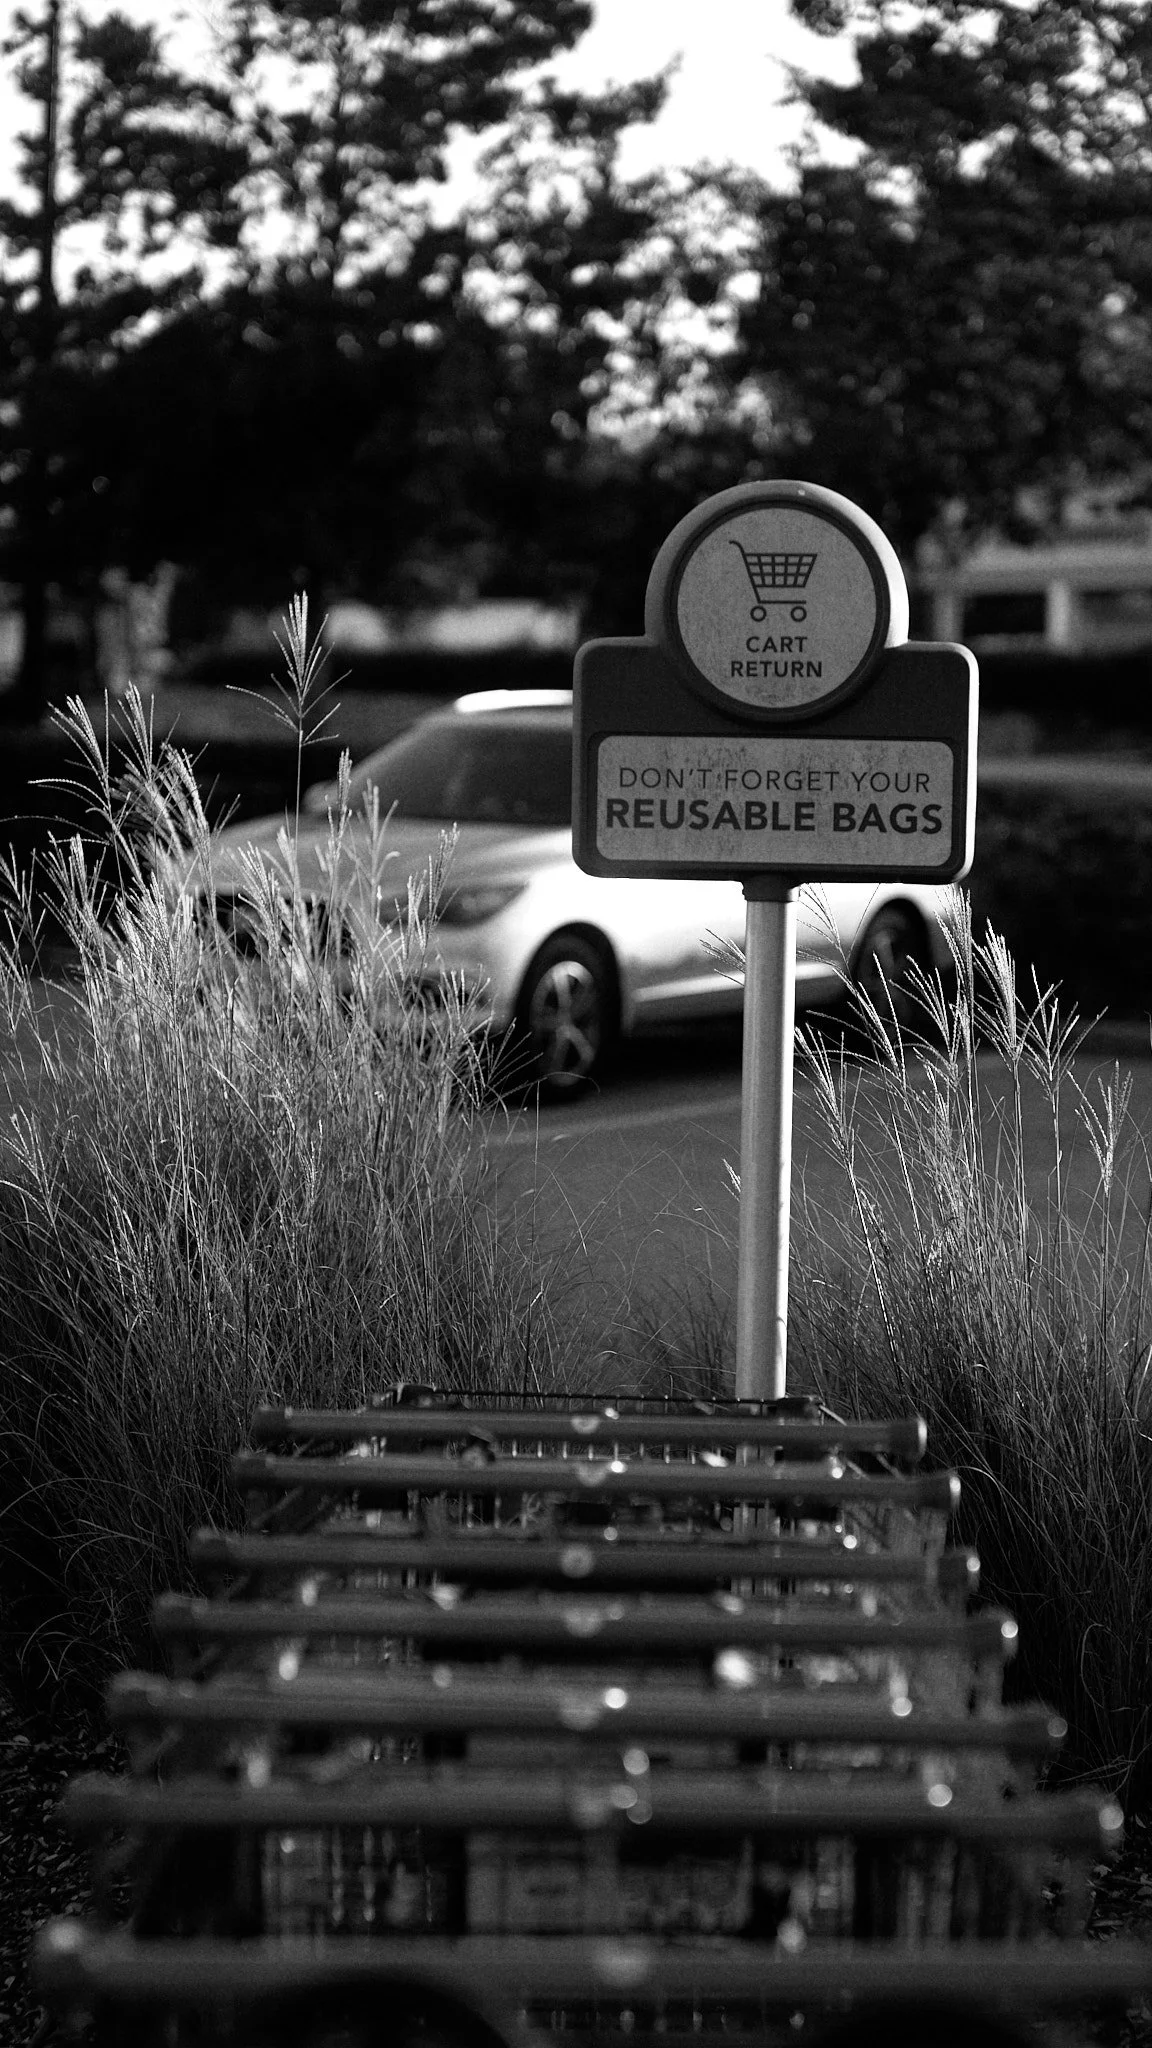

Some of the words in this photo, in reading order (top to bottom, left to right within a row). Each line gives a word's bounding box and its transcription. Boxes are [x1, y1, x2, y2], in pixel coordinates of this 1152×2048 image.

[746, 636, 808, 653] CART
[731, 660, 823, 678] RETURN
[619, 767, 713, 789] DON'T
[724, 769, 840, 793] FORGET
[851, 771, 930, 793] YOUR
[605, 798, 816, 831] REUSABLE
[832, 802, 943, 834] BAGS
